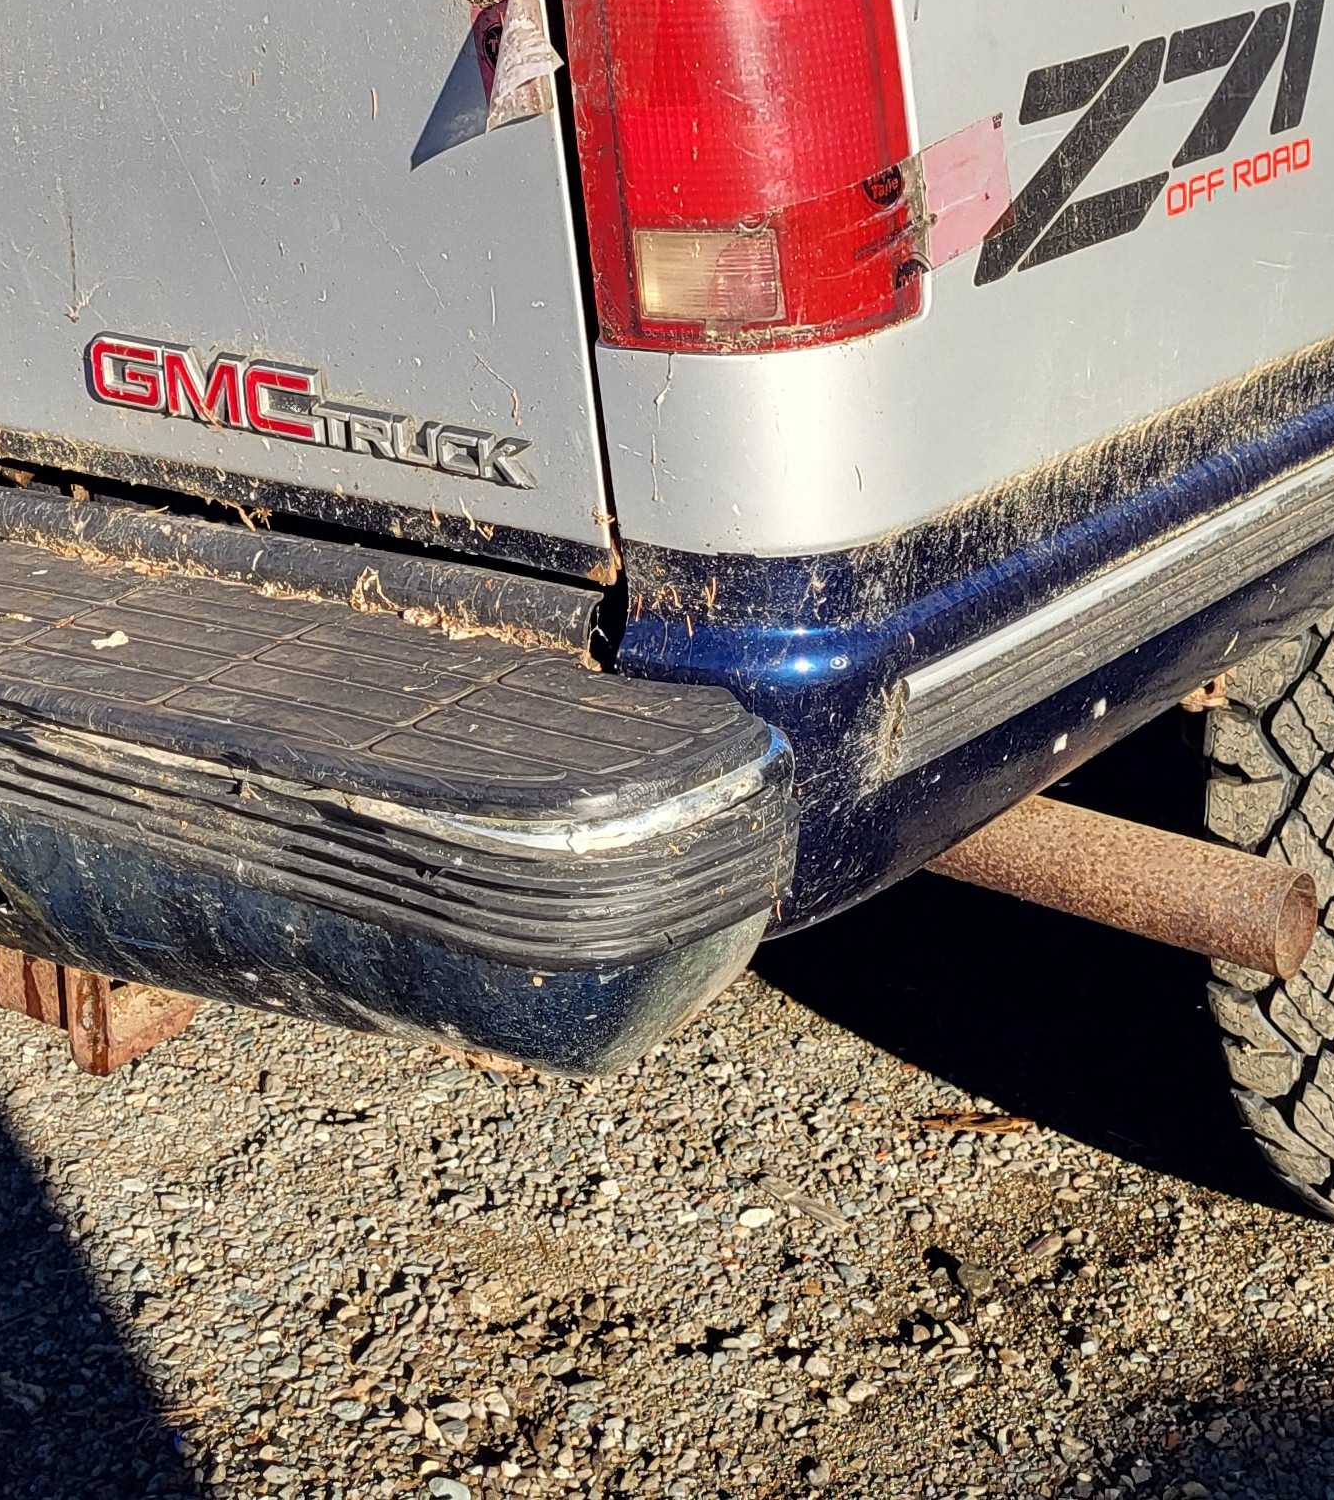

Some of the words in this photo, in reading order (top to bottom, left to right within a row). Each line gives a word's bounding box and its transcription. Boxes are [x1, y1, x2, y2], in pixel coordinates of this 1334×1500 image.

[1166, 167, 1225, 216] OFF
[1232, 138, 1312, 188] ROAD
[83, 330, 322, 445] GMC
[312, 400, 539, 490] TRUCK
